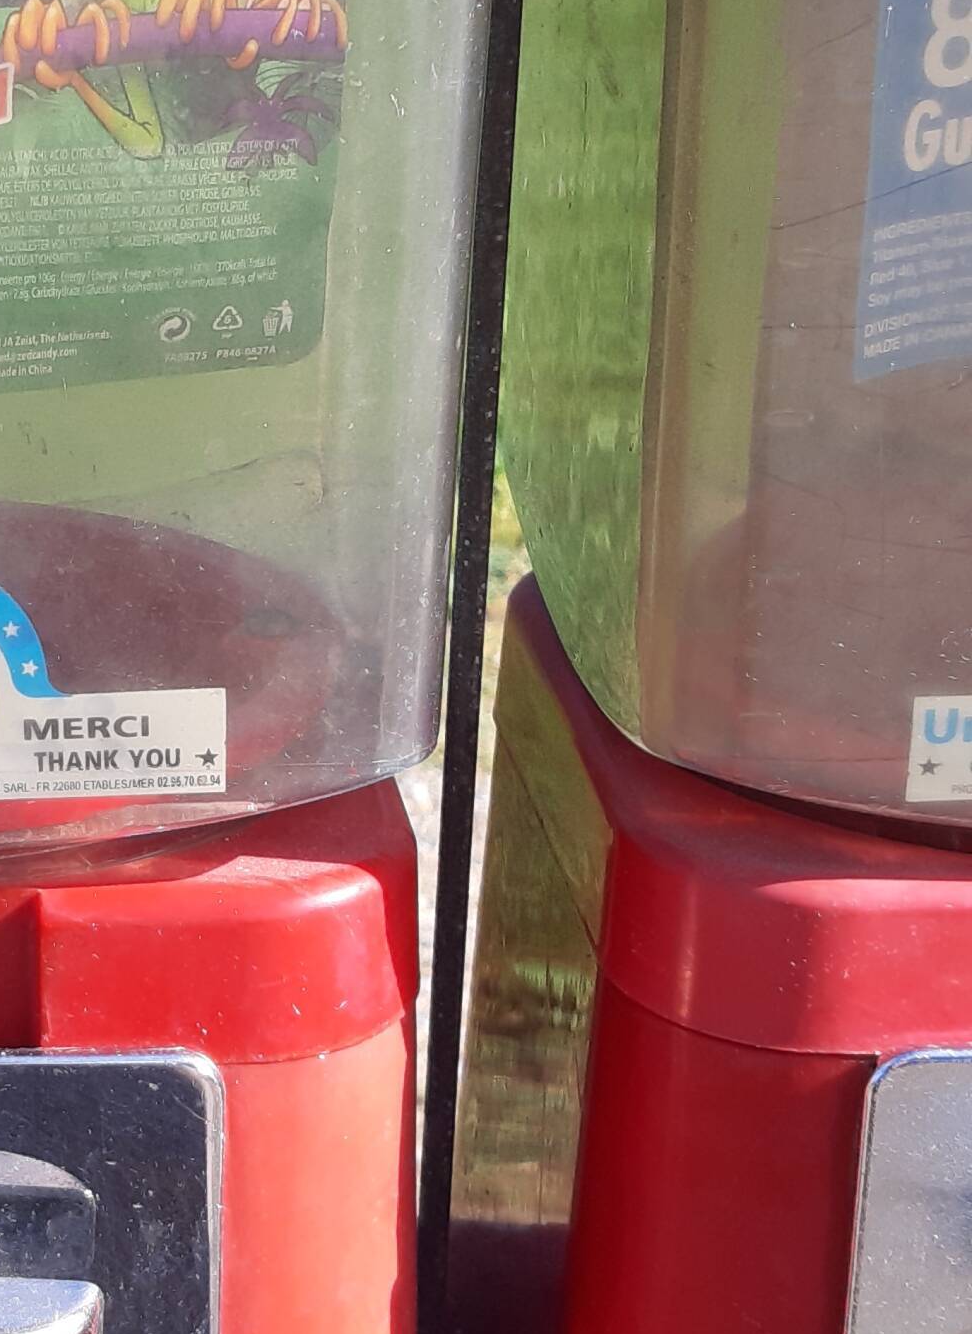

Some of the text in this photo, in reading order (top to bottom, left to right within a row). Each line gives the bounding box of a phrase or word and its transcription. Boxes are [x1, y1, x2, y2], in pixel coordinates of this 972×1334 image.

[23, 715, 150, 740] MERCI
[33, 748, 182, 773] THANK YOU
